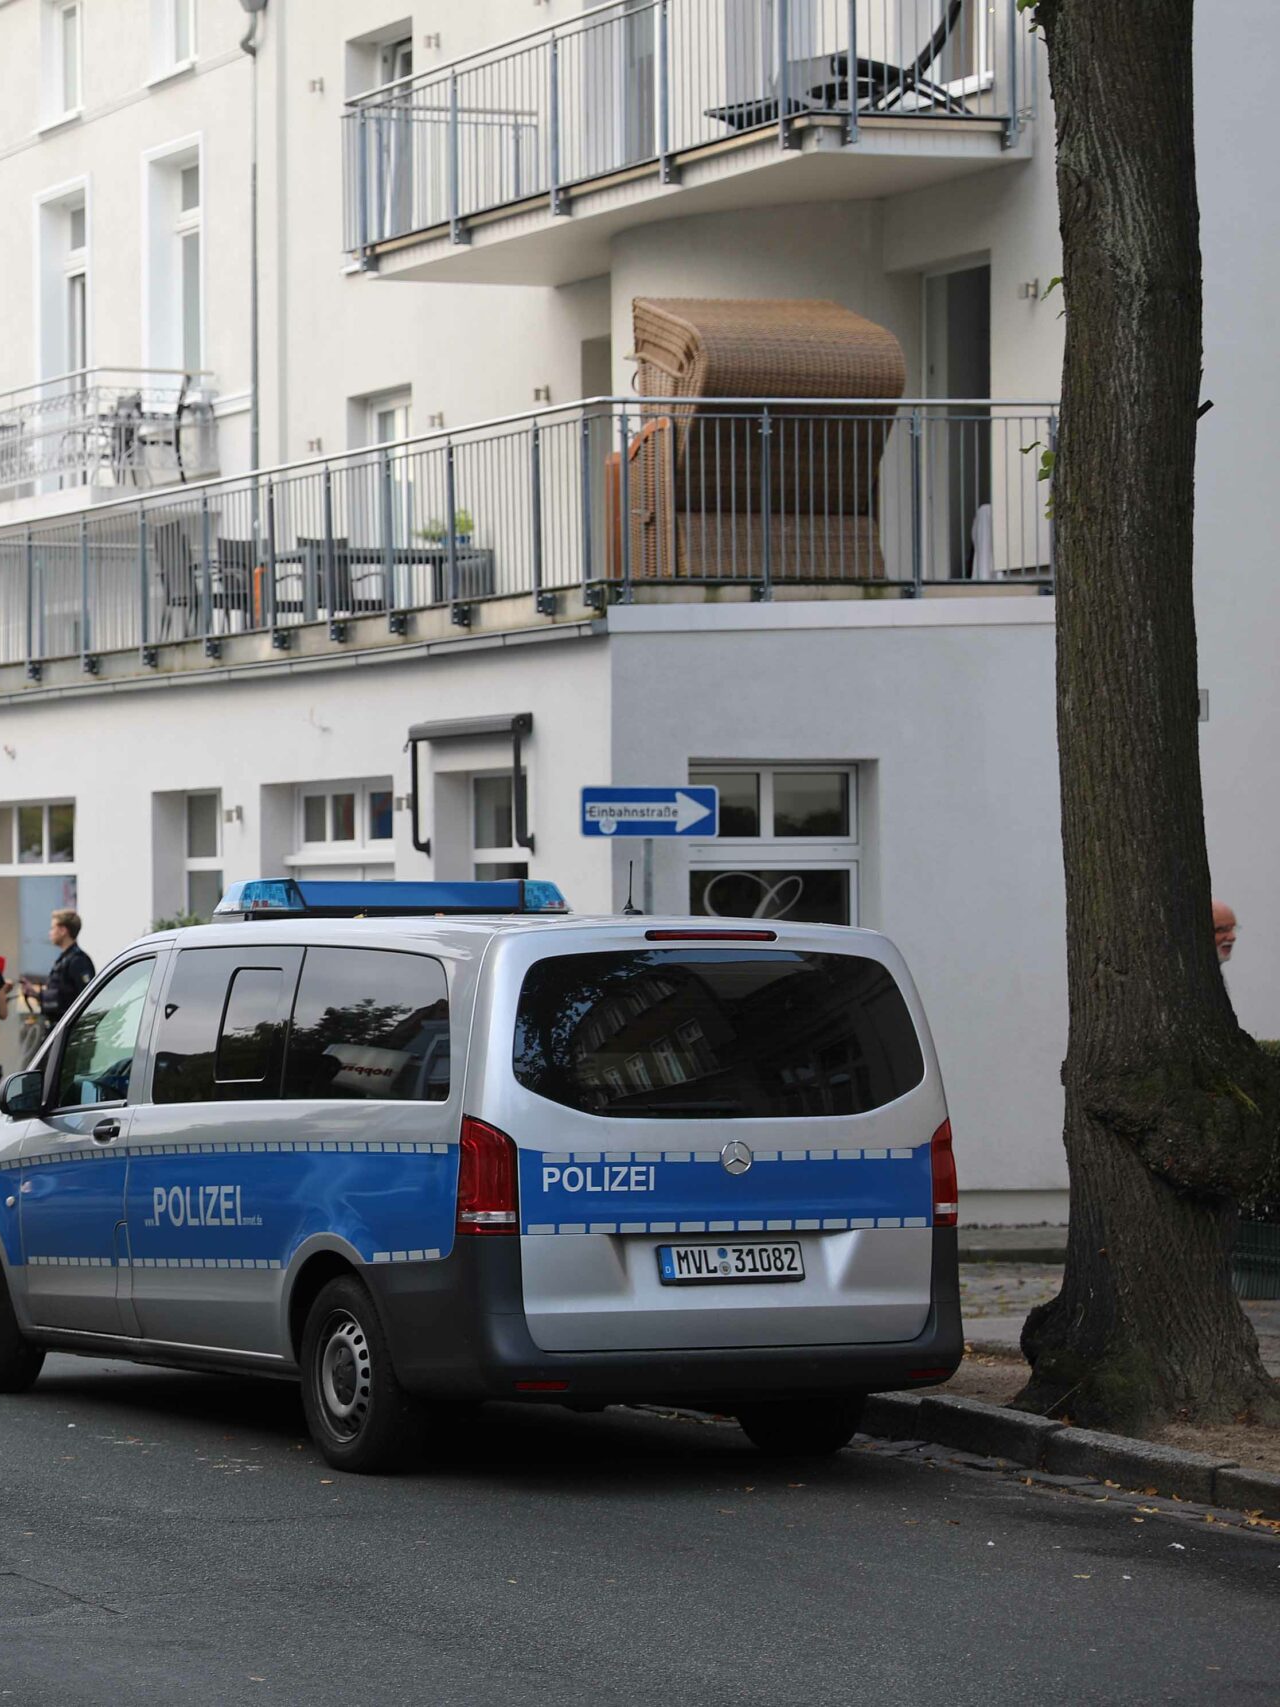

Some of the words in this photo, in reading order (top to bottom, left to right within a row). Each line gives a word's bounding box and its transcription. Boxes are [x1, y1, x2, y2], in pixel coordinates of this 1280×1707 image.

[588, 805, 678, 818] Einbahnstraße
[542, 1166, 655, 1192] POLIZEI
[676, 1249, 718, 1275] MVL
[731, 1247, 798, 1273] 31082
